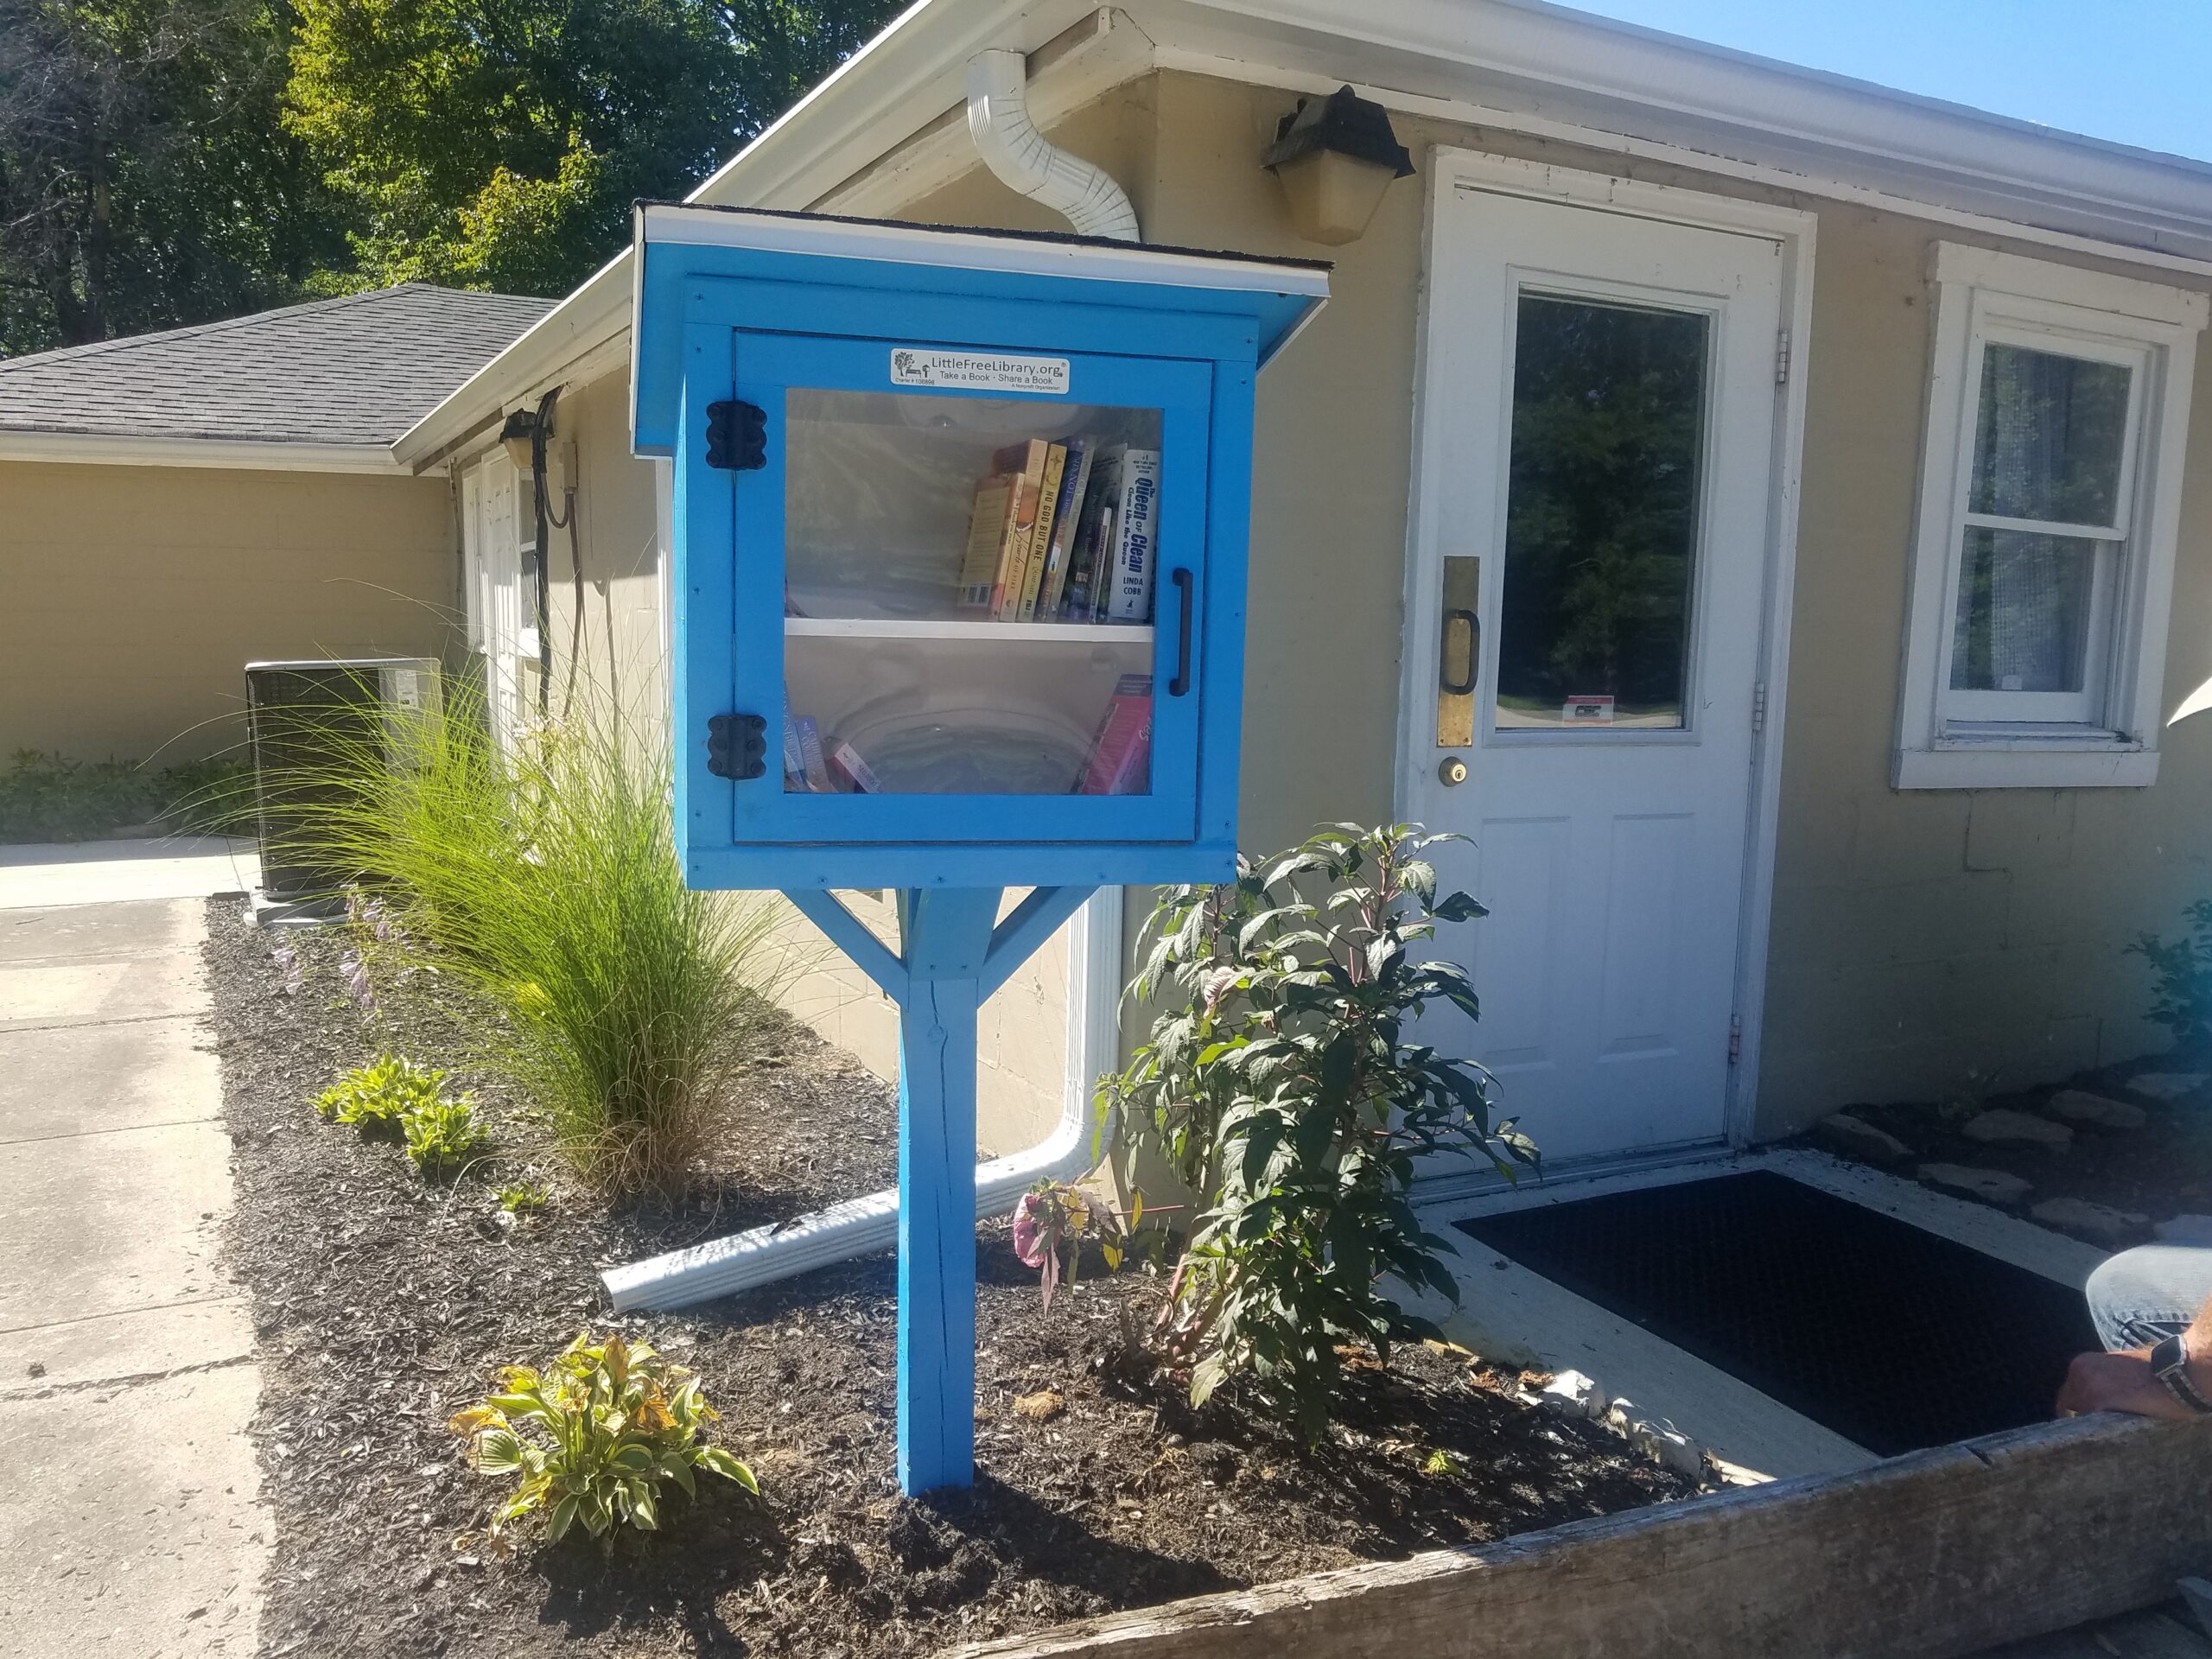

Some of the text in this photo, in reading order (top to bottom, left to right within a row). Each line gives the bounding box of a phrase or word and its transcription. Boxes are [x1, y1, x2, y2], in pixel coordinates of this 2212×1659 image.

[931, 357, 1061, 378] LittleFreeLibrary.org
[939, 371, 959, 380] Take
[969, 372, 990, 382] Book
[998, 373, 1022, 384] Share
[1032, 375, 1053, 385] Book
[1126, 486, 1135, 507] Clean
[1134, 477, 1154, 521] Queen
[1033, 490, 1054, 562] NO GOD BUT ONE
[1124, 509, 1133, 525] Like
[1121, 541, 1129, 565] Queen
[1128, 533, 1148, 574] Clean
[1122, 577, 1144, 586] LINDA
[1123, 587, 1142, 595] COBB
